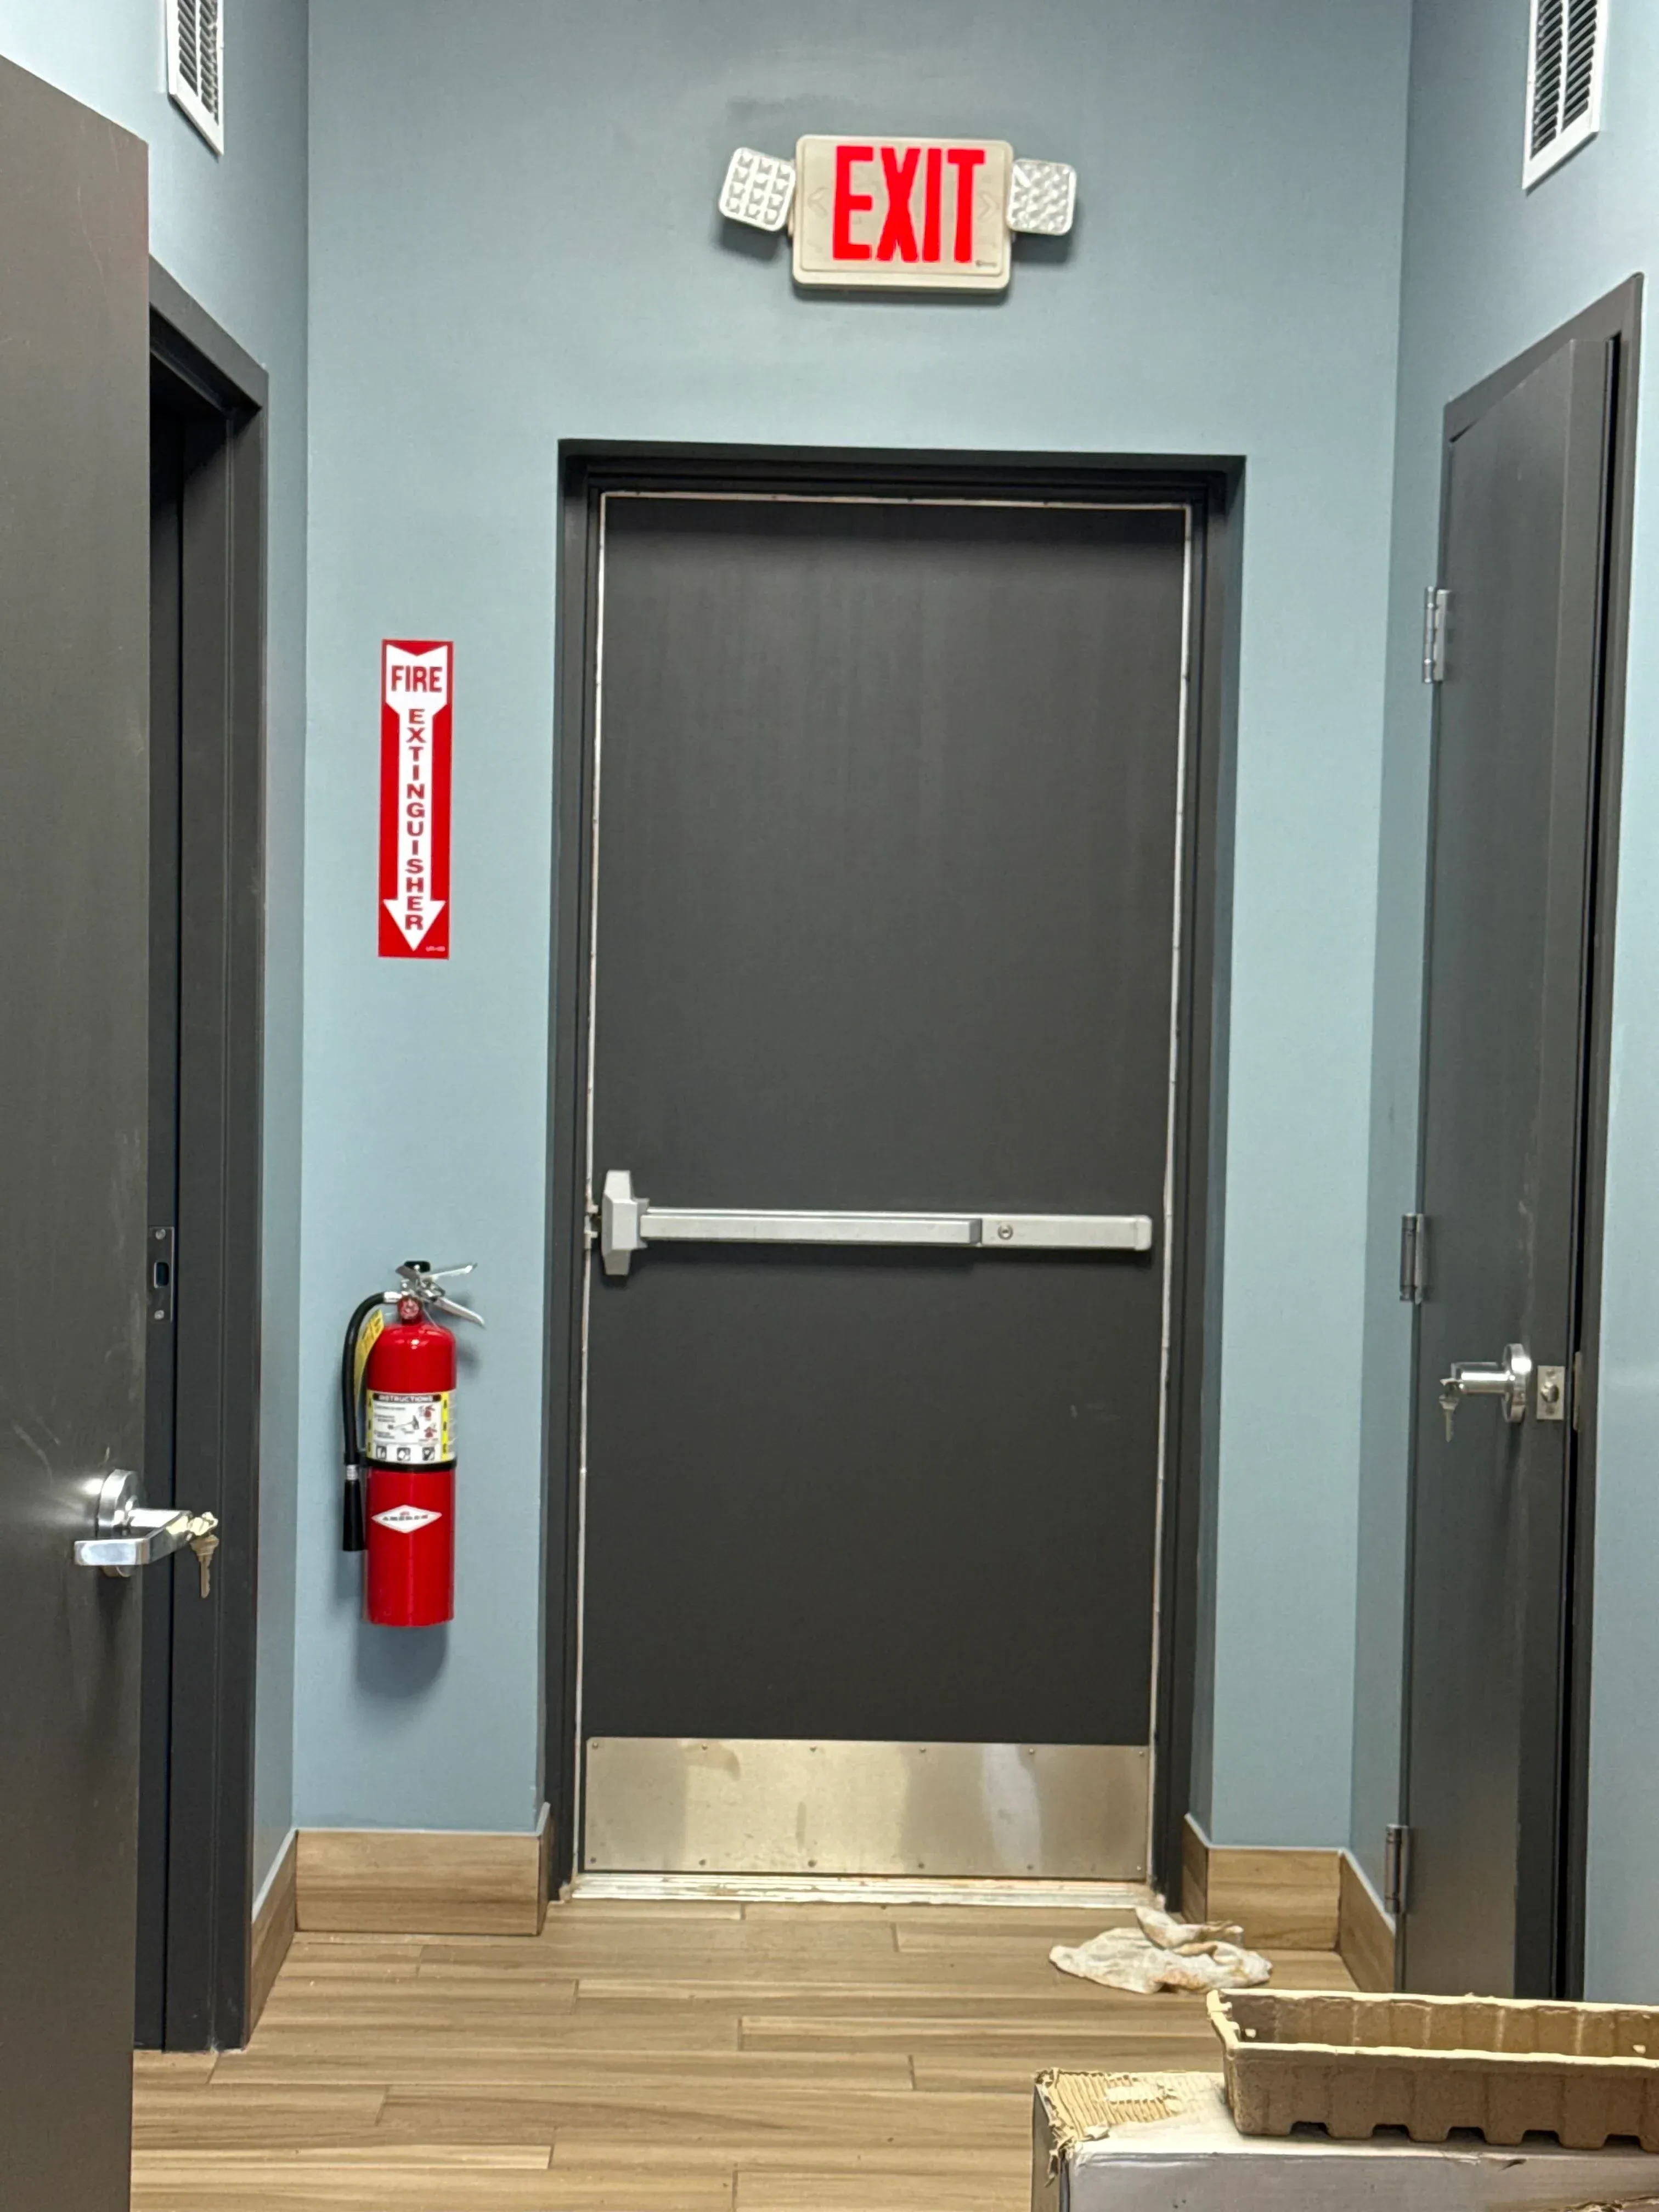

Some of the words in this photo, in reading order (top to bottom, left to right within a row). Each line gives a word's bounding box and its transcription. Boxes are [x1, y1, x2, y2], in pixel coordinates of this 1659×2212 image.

[832, 145, 986, 264] EXIT
[391, 665, 442, 693] FIRE
[405, 708, 426, 931] EXTINGUISHER
